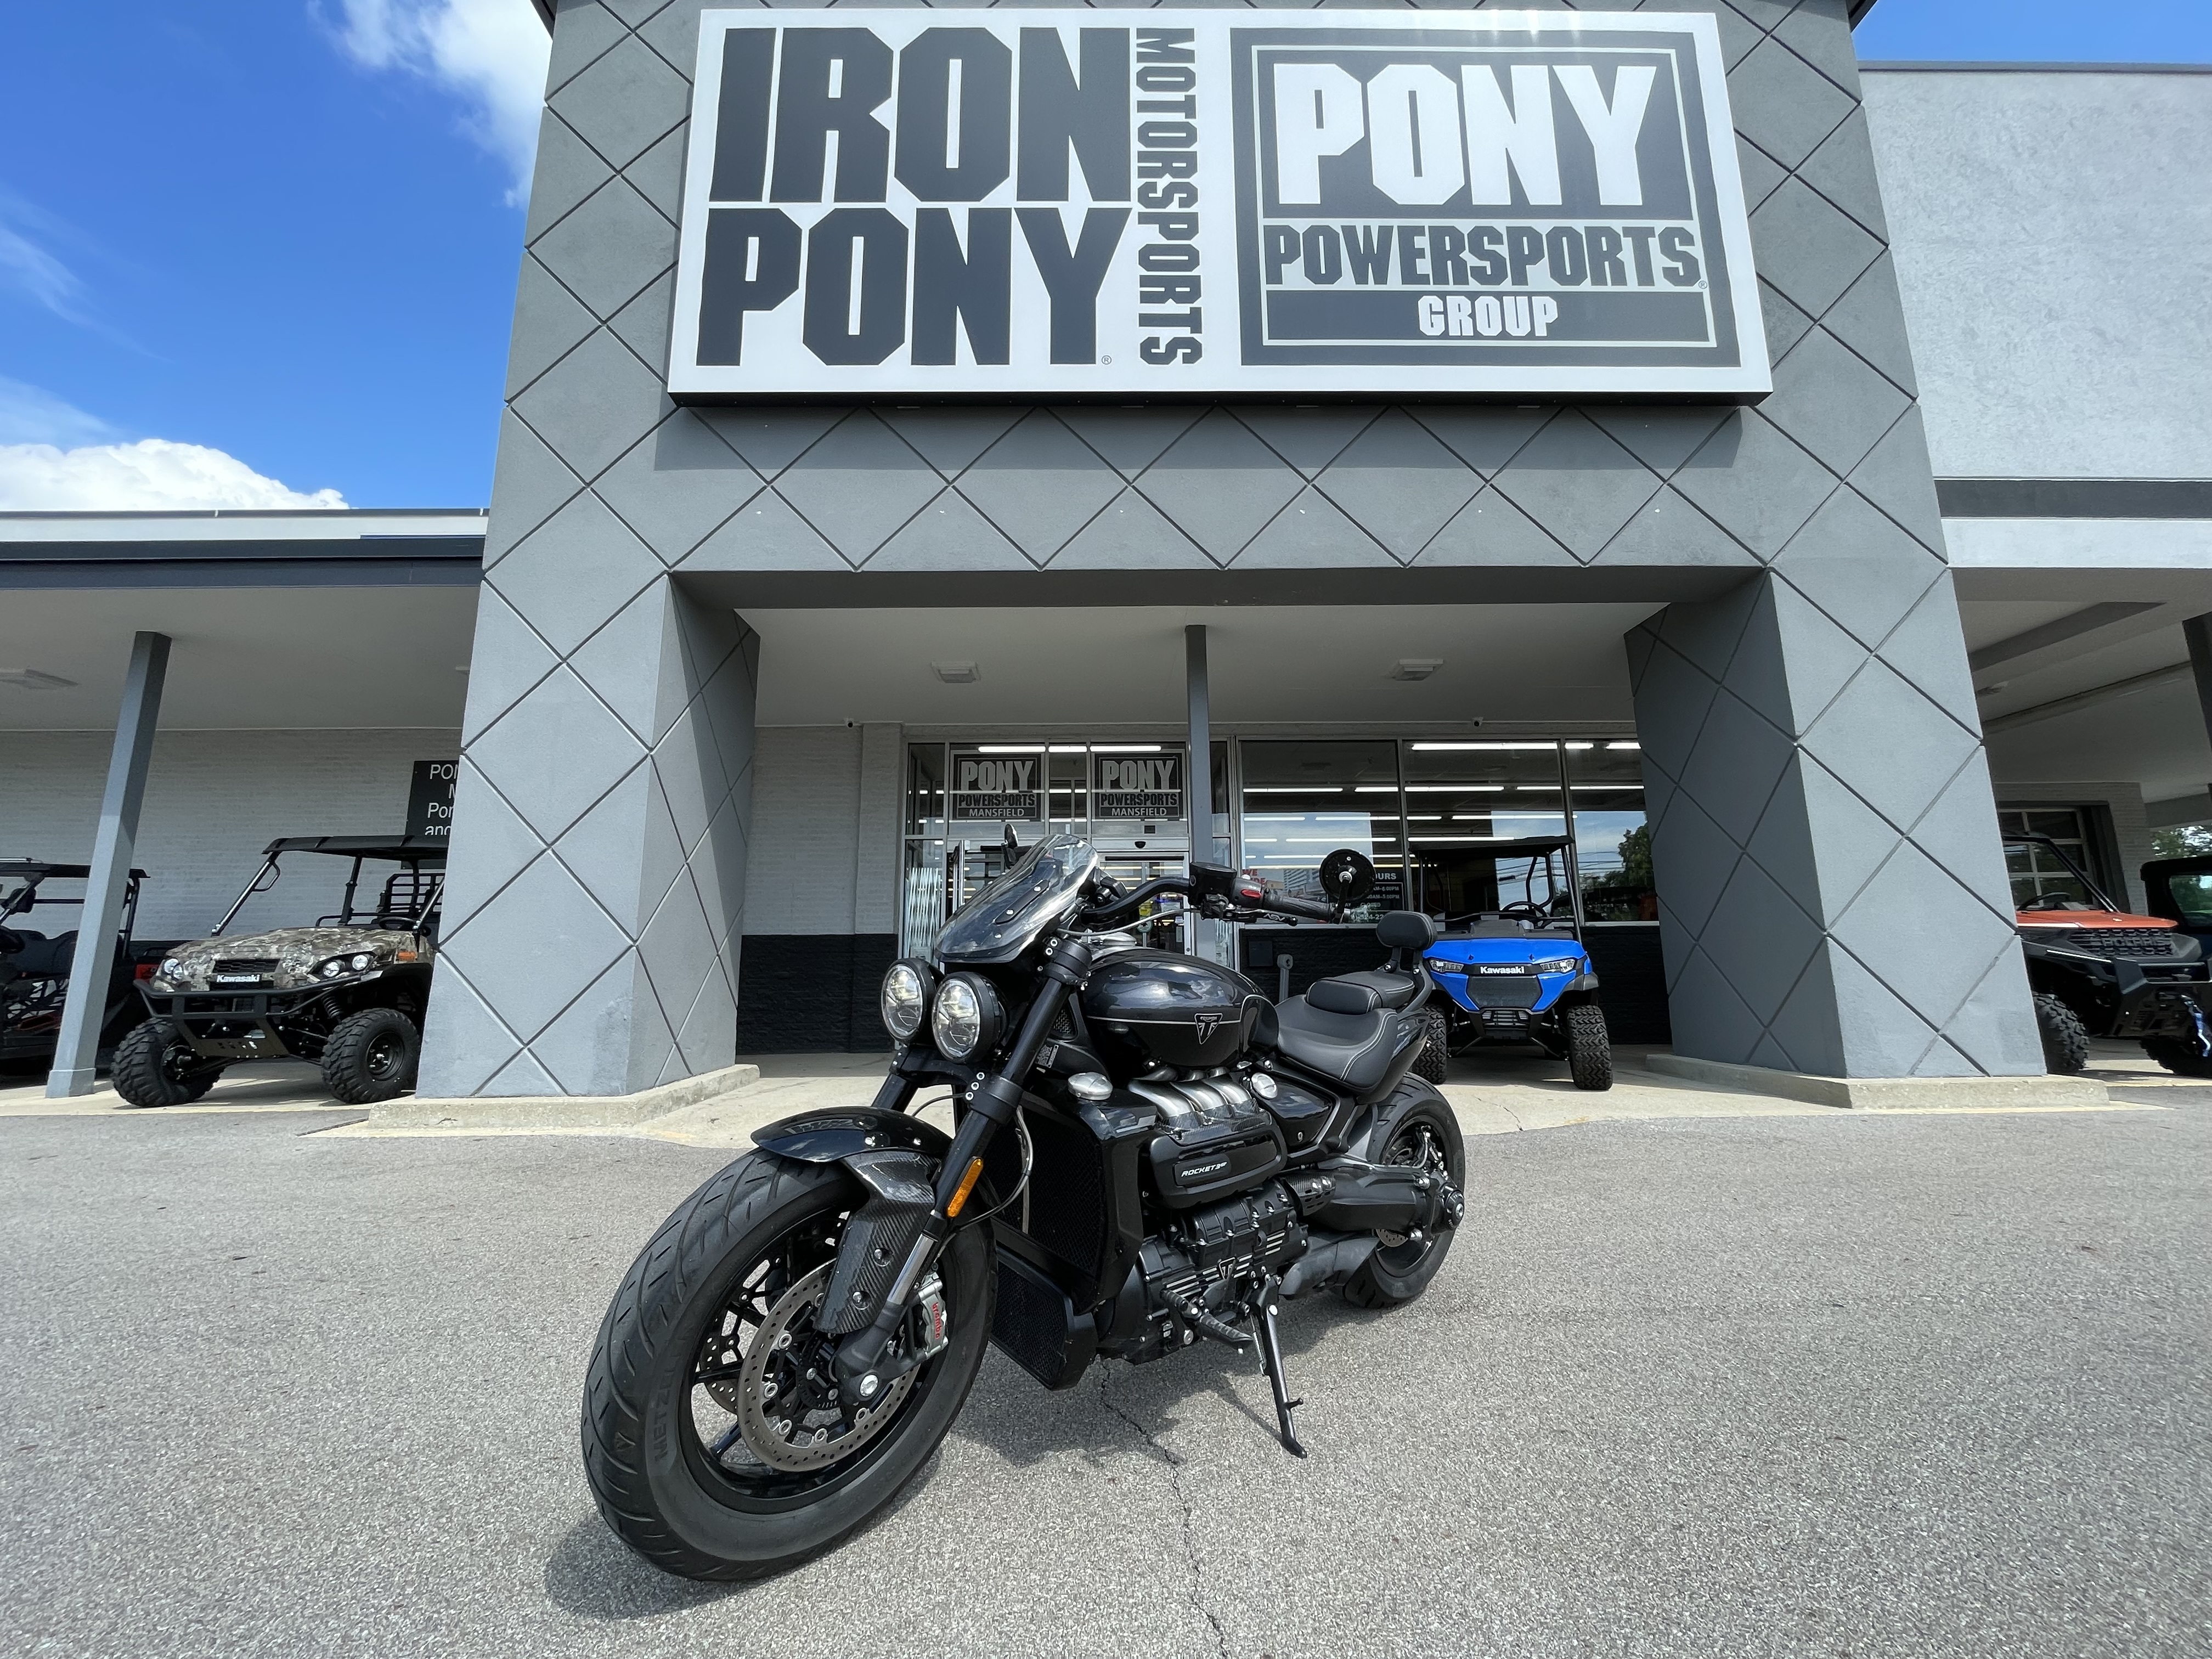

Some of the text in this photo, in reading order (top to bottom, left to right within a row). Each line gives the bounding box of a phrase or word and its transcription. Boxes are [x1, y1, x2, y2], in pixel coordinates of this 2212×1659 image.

[709, 27, 1131, 203] IRON
[1273, 63, 1657, 206] PONY
[1136, 27, 1203, 365] MOTORSPORTS
[1263, 224, 1701, 287] POWERSPORTS
[696, 207, 1133, 366] PONY
[1417, 295, 1559, 337] GROUP
[961, 761, 1034, 791] PONY
[1102, 760, 1175, 790] PONY
[958, 794, 1035, 807] POWERSPORTS
[969, 809, 1025, 817] MANSFIELD
[1101, 793, 1177, 806] POWERSPORTS
[1111, 808, 1167, 816] MANSFIELD
[932, 1302, 942, 1339] brembo
